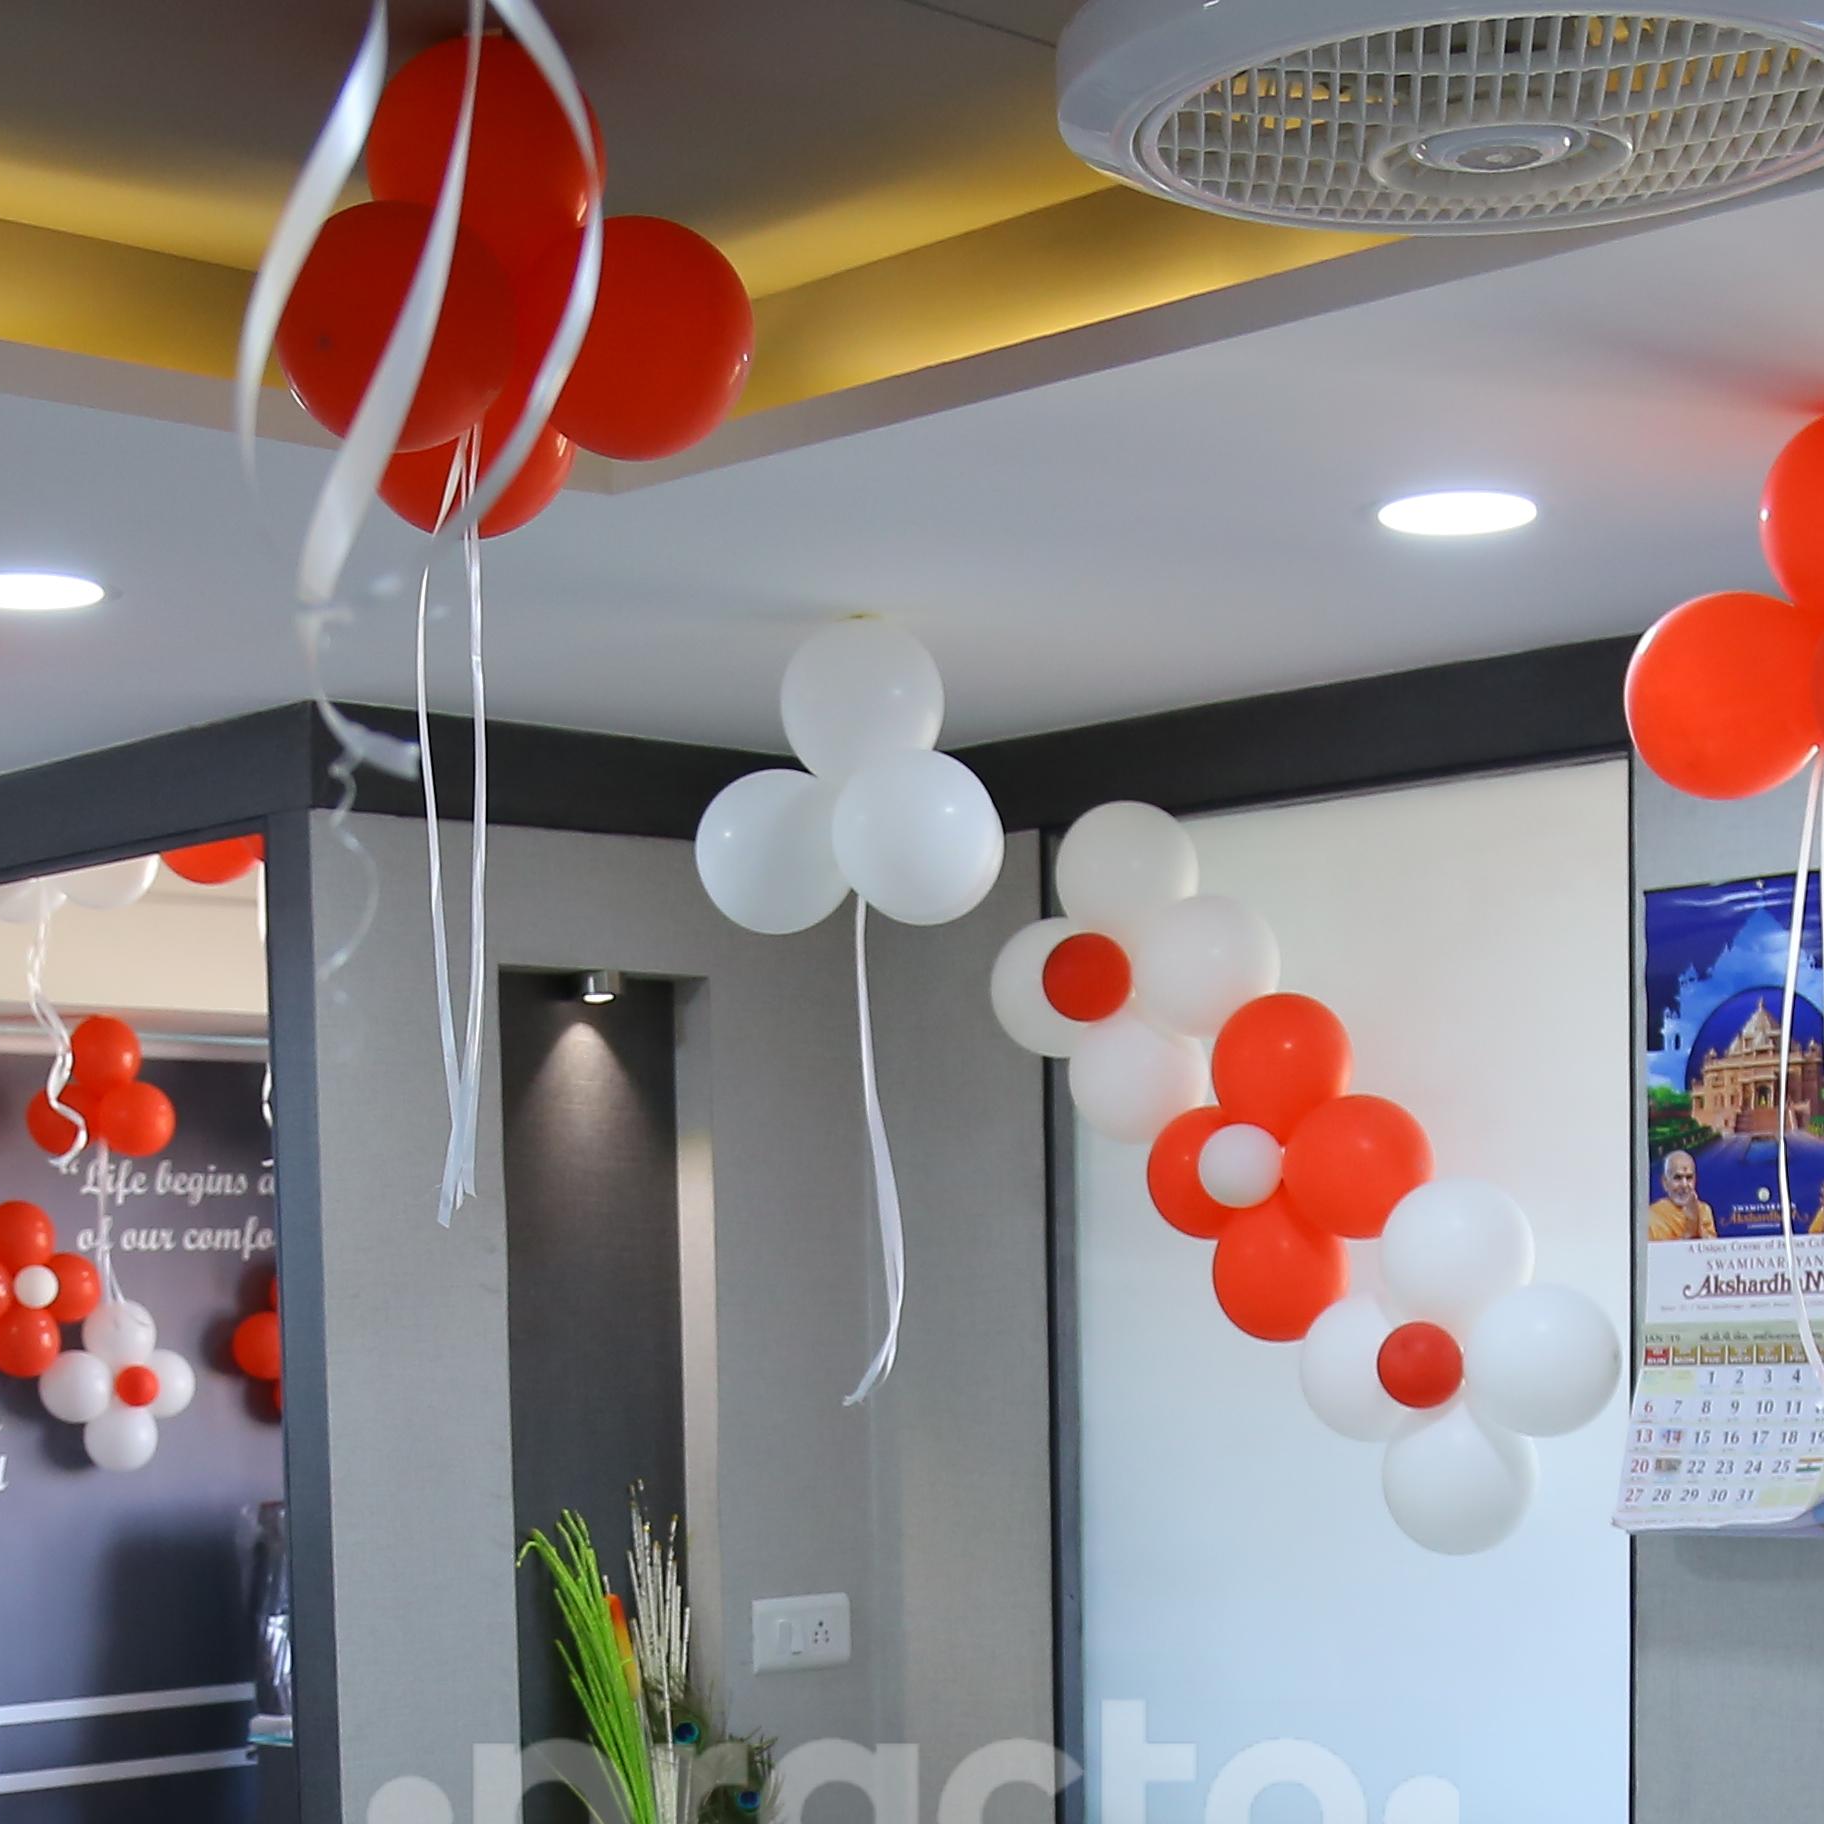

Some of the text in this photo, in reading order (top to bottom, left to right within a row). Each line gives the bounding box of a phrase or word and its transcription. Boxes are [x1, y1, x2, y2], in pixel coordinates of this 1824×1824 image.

[154, 1158, 249, 1206] begins
[120, 1226, 177, 1251] our
[1705, 1255, 1824, 1272] SWAMINARYAN
[1735, 1369, 1745, 1384] 2
[1763, 1369, 1773, 1384] 3
[1791, 1368, 1802, 1383] 4
[1644, 1400, 1654, 1414] 6
[1674, 1400, 1683, 1415] 7
[1701, 1400, 1712, 1415] 8
[1730, 1400, 1741, 1415] 9
[1756, 1400, 1775, 1415] 10
[1785, 1399, 1804, 1414] 11
[1635, 1428, 1654, 1444] 13
[1694, 1430, 1712, 1445] 15
[1723, 1430, 1741, 1445] 16
[1751, 1430, 1770, 1445] 17
[1780, 1430, 1798, 1445] 18
[1630, 1458, 1650, 1474] 20
[1686, 1460, 1707, 1474] 22
[1715, 1460, 1735, 1475] 23
[1743, 1460, 1763, 1475] 24
[1771, 1460, 1792, 1474] 25
[1625, 1488, 1755, 1502] 27 28 29 30 31
